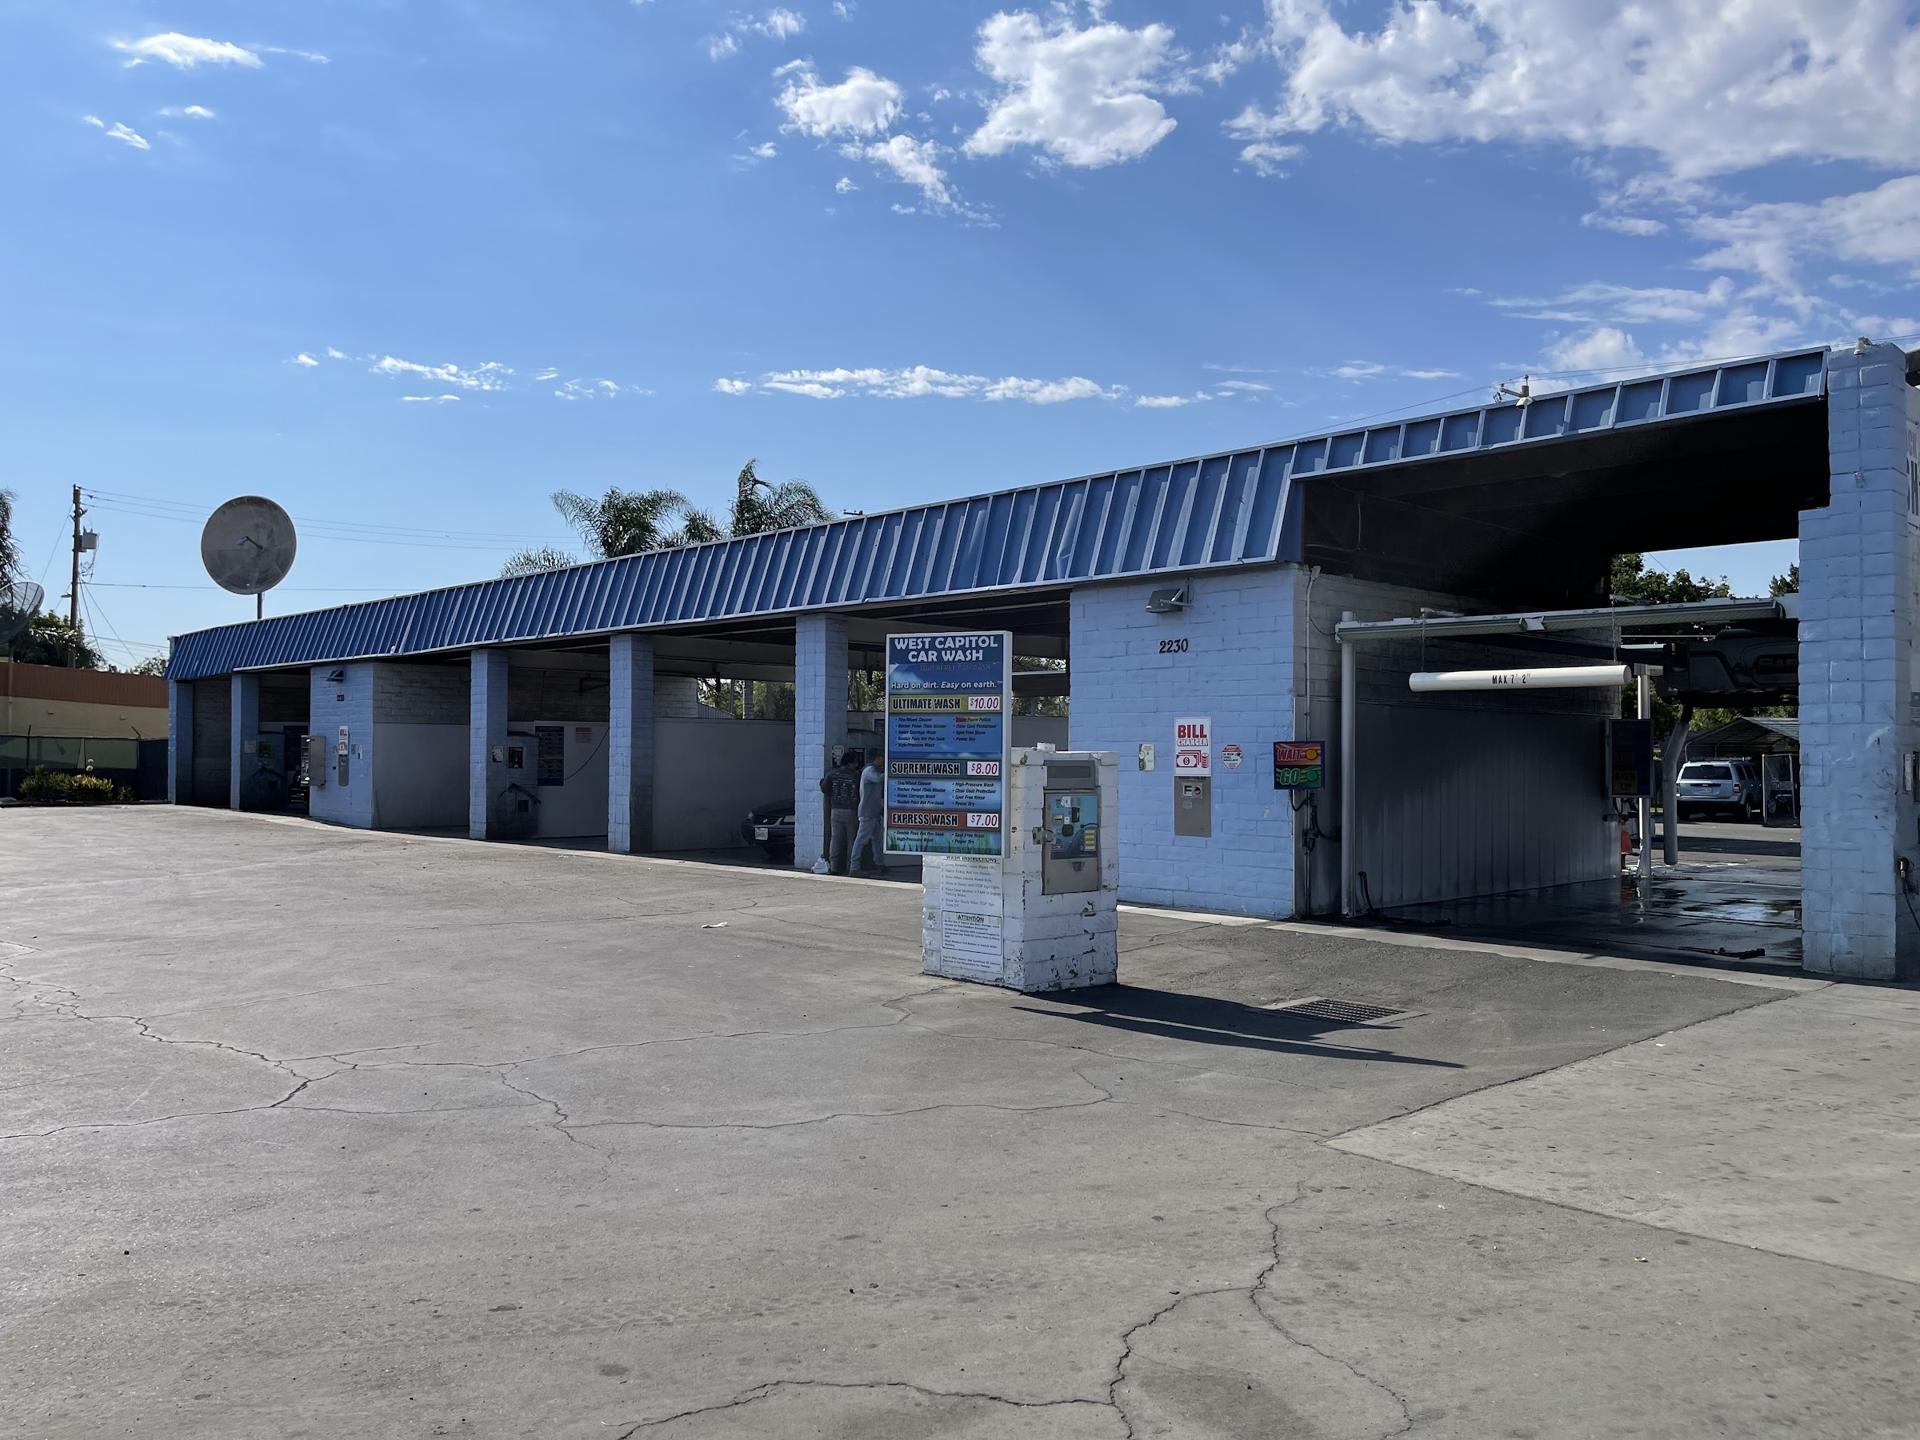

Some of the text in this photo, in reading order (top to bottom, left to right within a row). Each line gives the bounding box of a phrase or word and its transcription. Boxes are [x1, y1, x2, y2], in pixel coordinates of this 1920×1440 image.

[894, 636, 998, 650] WEST CAPITOL
[1158, 638, 1189, 654] 2230
[907, 649, 984, 662] CAR WASH
[922, 681, 939, 689] dirt.
[940, 681, 960, 690] Easy
[1491, 674, 1508, 685] MAX
[892, 698, 961, 710] ULTIMATE WASH
[970, 698, 1000, 709] $10.00
[1177, 724, 1207, 739] BILL
[1177, 738, 1209, 747] CHANGER
[1277, 748, 1303, 761] WAIT
[891, 763, 960, 775] SUPREME WASH
[971, 763, 998, 775] $8.00
[1279, 767, 1301, 786] GO
[892, 813, 958, 826] EXPRESS WASH
[971, 814, 998, 826] $7.00
[957, 914, 985, 923] ATTENTION
